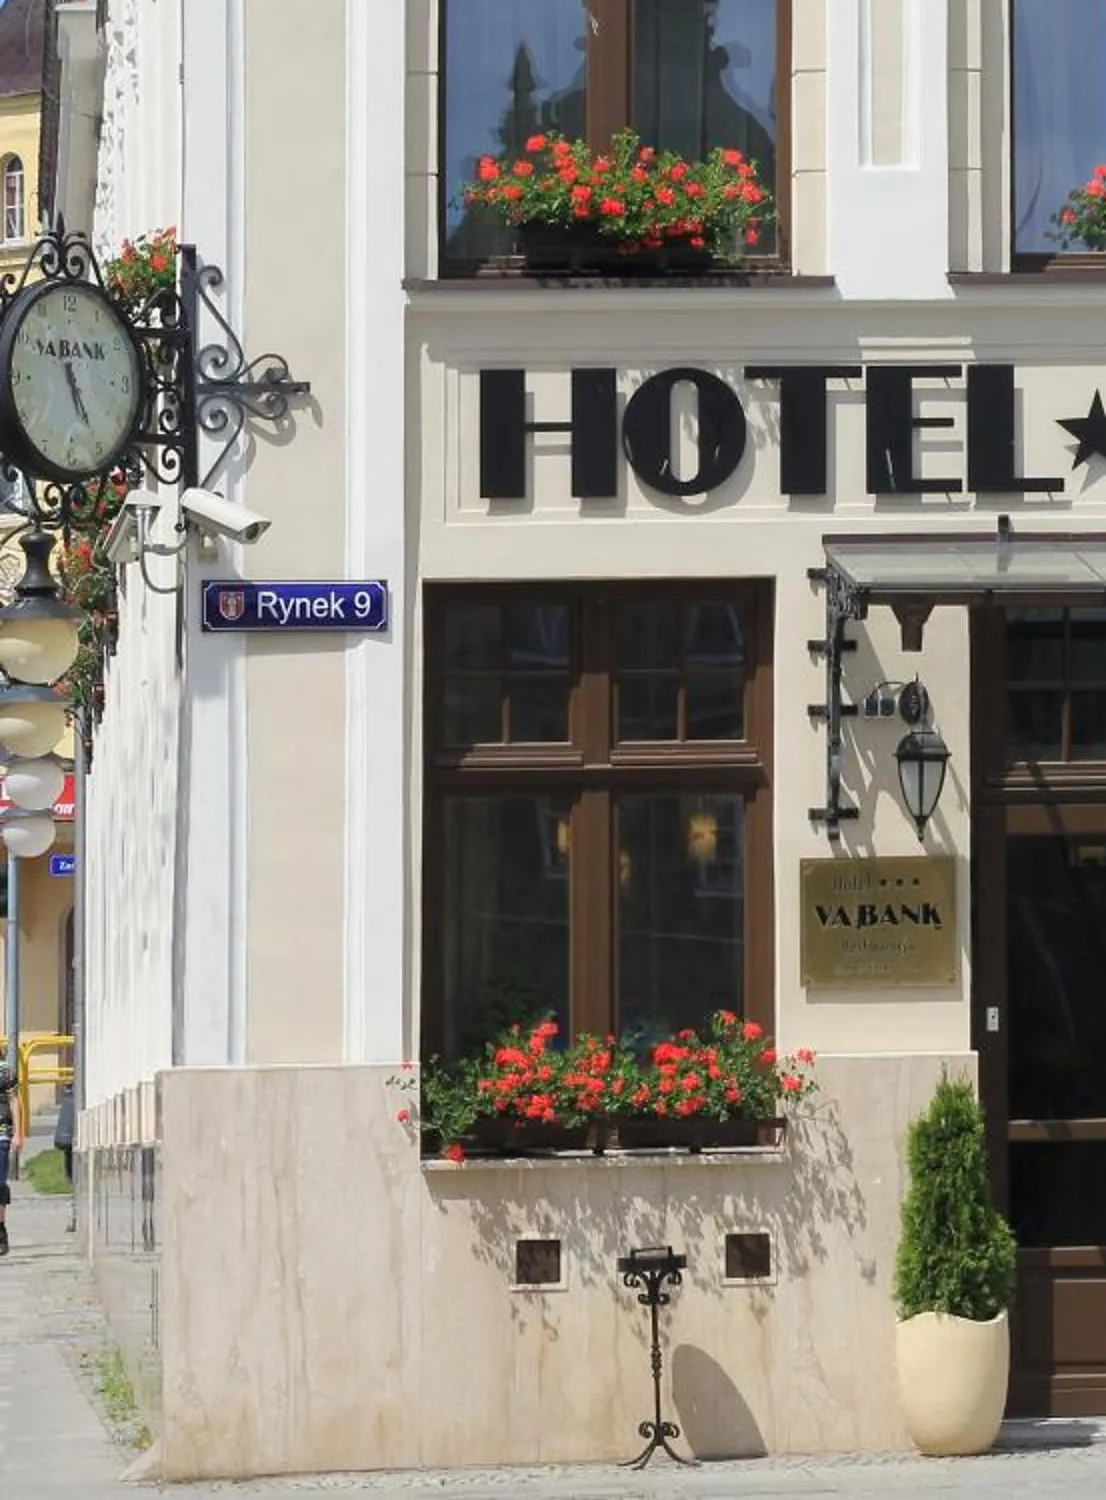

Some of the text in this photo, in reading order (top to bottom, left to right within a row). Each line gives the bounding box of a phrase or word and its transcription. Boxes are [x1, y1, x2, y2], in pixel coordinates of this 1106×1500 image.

[480, 364, 1065, 499] HOTEL
[257, 590, 371, 625] Rynek 9
